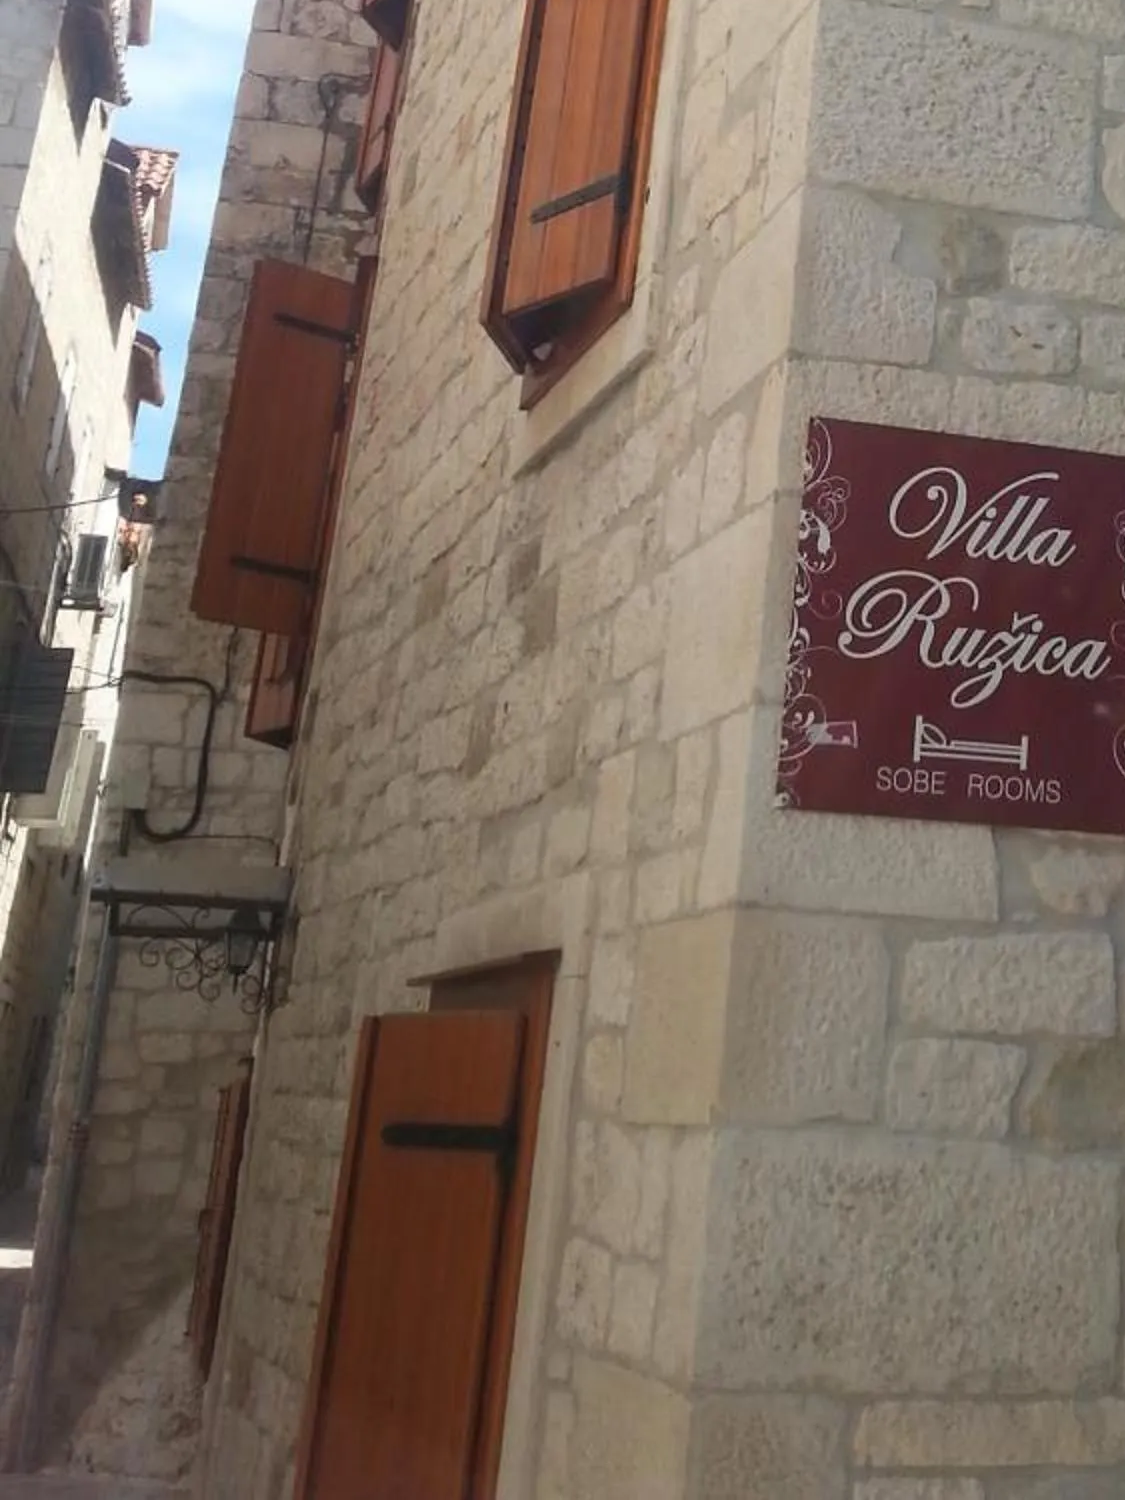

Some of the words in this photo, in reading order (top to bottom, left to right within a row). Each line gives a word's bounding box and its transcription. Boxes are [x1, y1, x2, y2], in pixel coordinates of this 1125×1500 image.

[889, 466, 1077, 567] Villa
[837, 570, 1112, 709] Ružica
[876, 766, 946, 795] SOBE
[967, 773, 1062, 803] ROOMS
